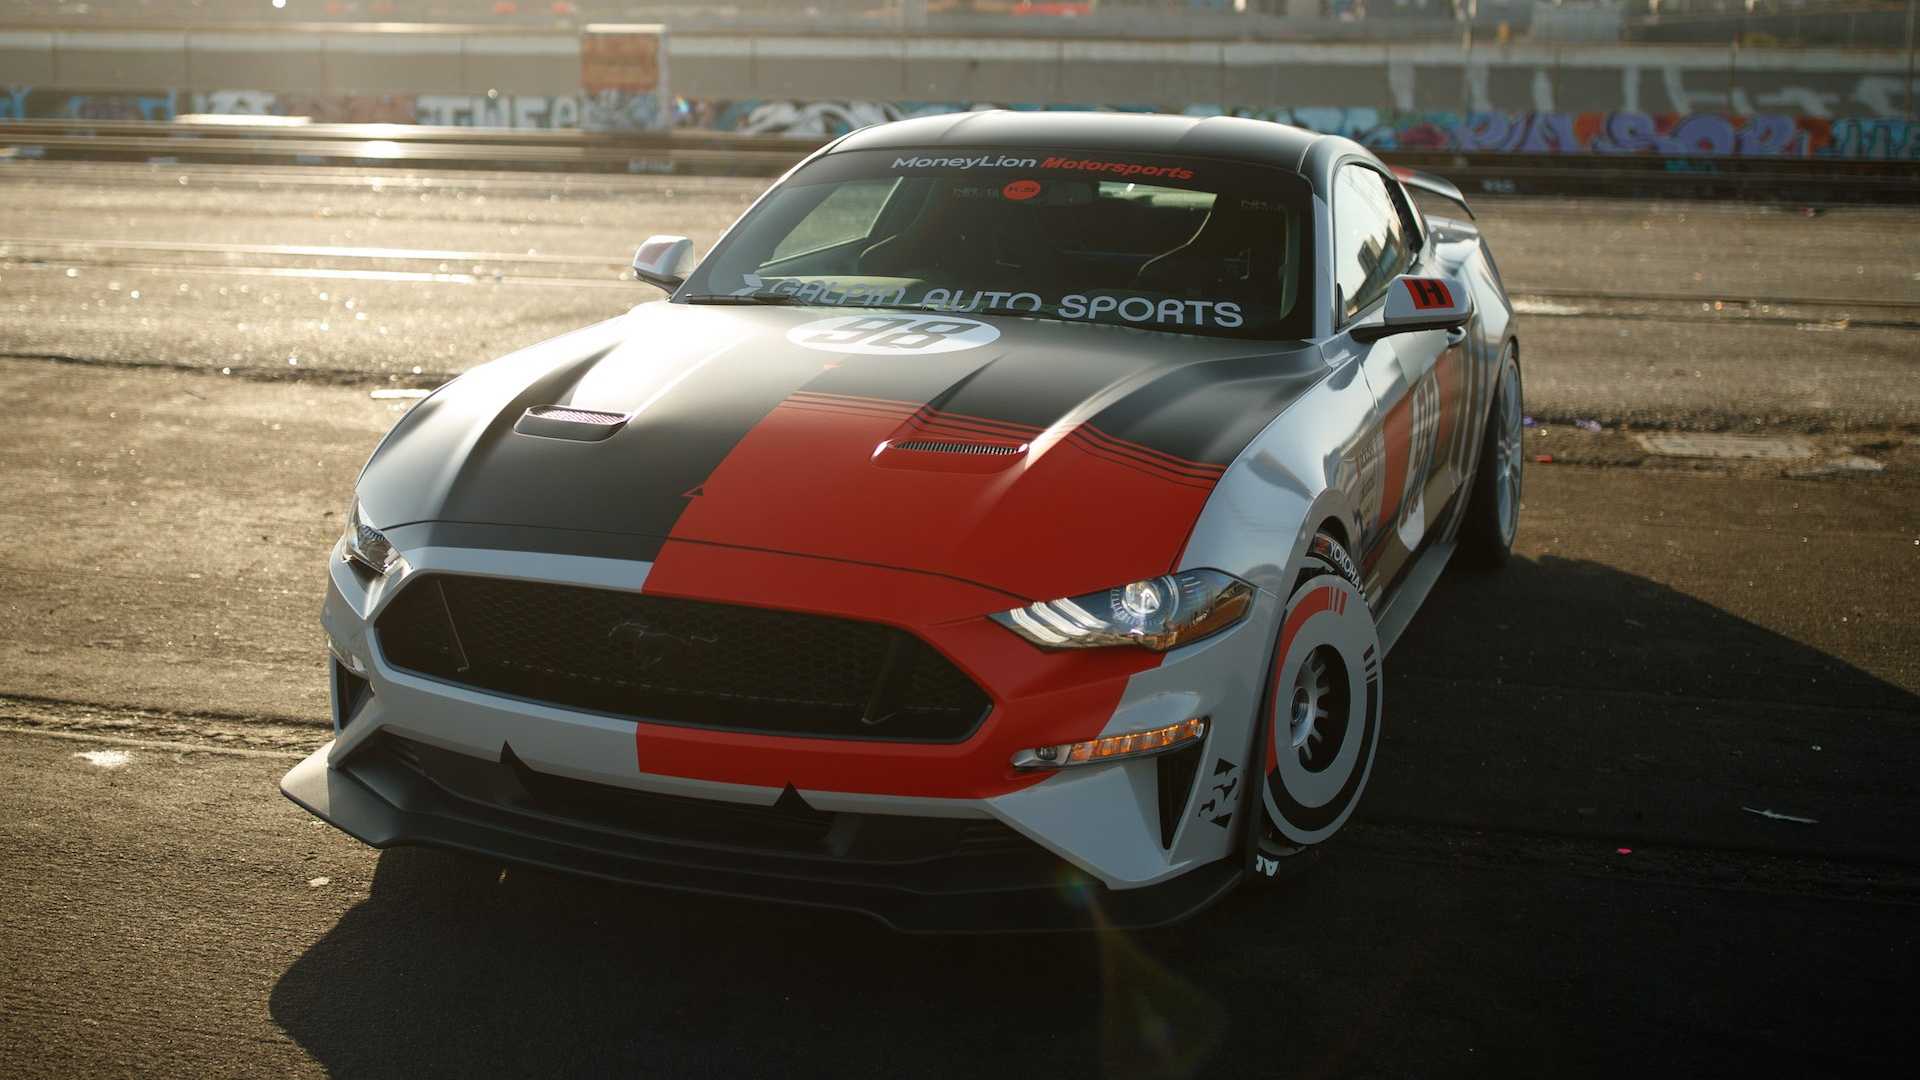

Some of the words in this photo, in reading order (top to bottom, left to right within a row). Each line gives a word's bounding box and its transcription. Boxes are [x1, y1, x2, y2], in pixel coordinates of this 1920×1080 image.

[890, 155, 1037, 170] MoneyLion
[1039, 157, 1195, 181] Motorsports
[920, 287, 1042, 313] AUTO
[1057, 293, 1245, 328] SPORTS
[1413, 278, 1447, 306] H
[802, 316, 981, 349] 98
[1329, 542, 1365, 598] YOKOHA
